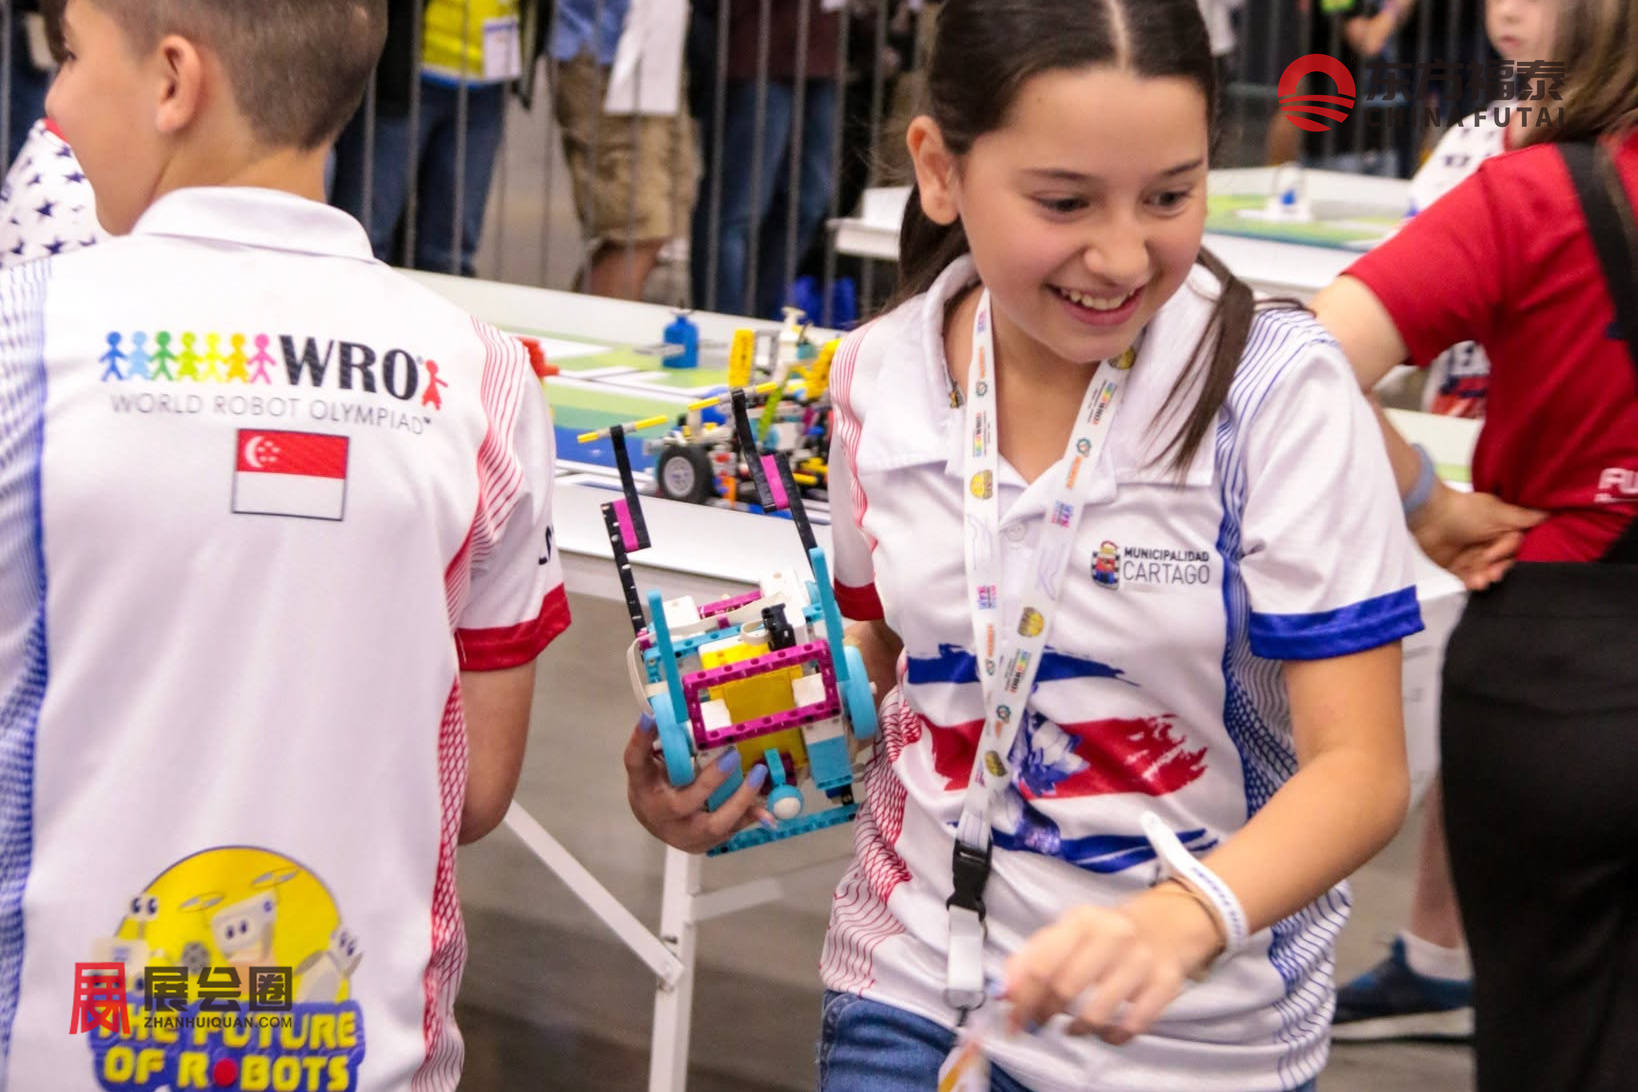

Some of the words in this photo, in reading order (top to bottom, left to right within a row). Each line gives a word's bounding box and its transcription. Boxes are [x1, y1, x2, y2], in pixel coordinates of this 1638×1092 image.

[278, 335, 418, 400] WRO
[111, 392, 202, 414] WORLD
[214, 394, 300, 417] ROBOT
[1124, 547, 1209, 562] MUNICIPALIDAD
[1123, 560, 1210, 584] CARTAGO
[193, 1010, 357, 1050] FUTURE
[104, 1046, 165, 1084] OF
